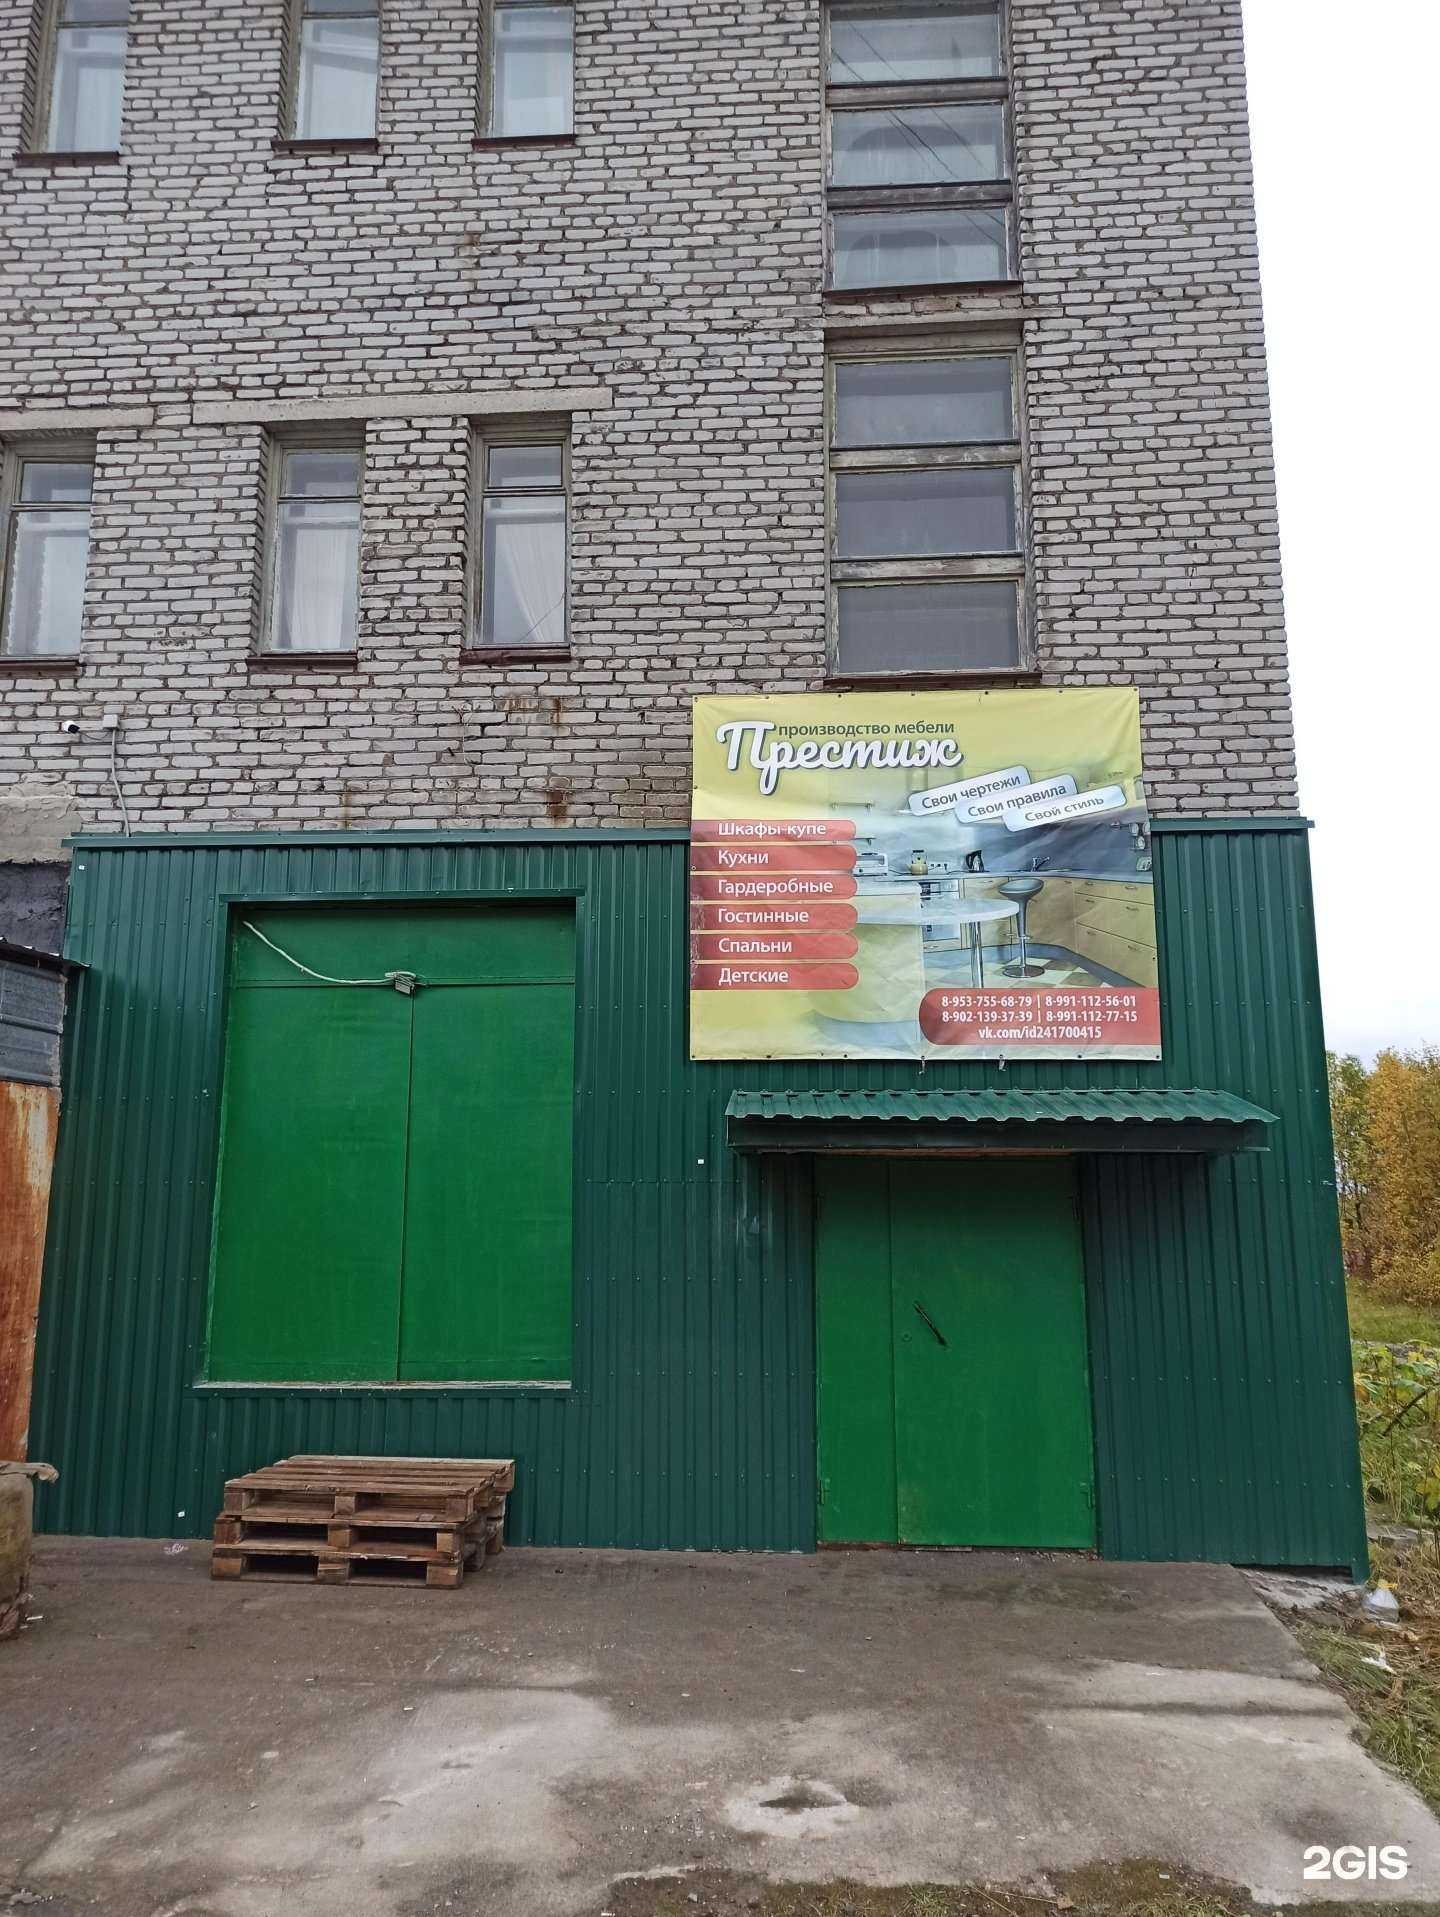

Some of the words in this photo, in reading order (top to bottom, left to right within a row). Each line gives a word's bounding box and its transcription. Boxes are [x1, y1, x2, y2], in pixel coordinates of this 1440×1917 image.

[779, 722, 890, 738] производство
[895, 720, 955, 734] мебели
[716, 720, 964, 795] Престиж
[922, 792, 957, 809] Свои
[960, 774, 1021, 799] чертежи
[967, 800, 1004, 818] Свои
[1006, 784, 1067, 808] правила
[1024, 806, 1061, 822] Свой
[1064, 797, 1104, 814] стиль
[718, 822, 827, 839] Шкафы-купе
[718, 850, 769, 867] Кухни
[718, 878, 834, 896] Гардеробные
[718, 908, 809, 923] Гостинные
[718, 938, 792, 953] Спальни
[718, 968, 789, 985] Детские
[941, 996, 1032, 1008] 8-953-755-68-79
[1045, 995, 1136, 1007] 8-991-112-56-01
[1046, 1011, 1138, 1022] 8-991-112-77-15
[978, 1026, 1102, 1039] vk.com/id241700415
